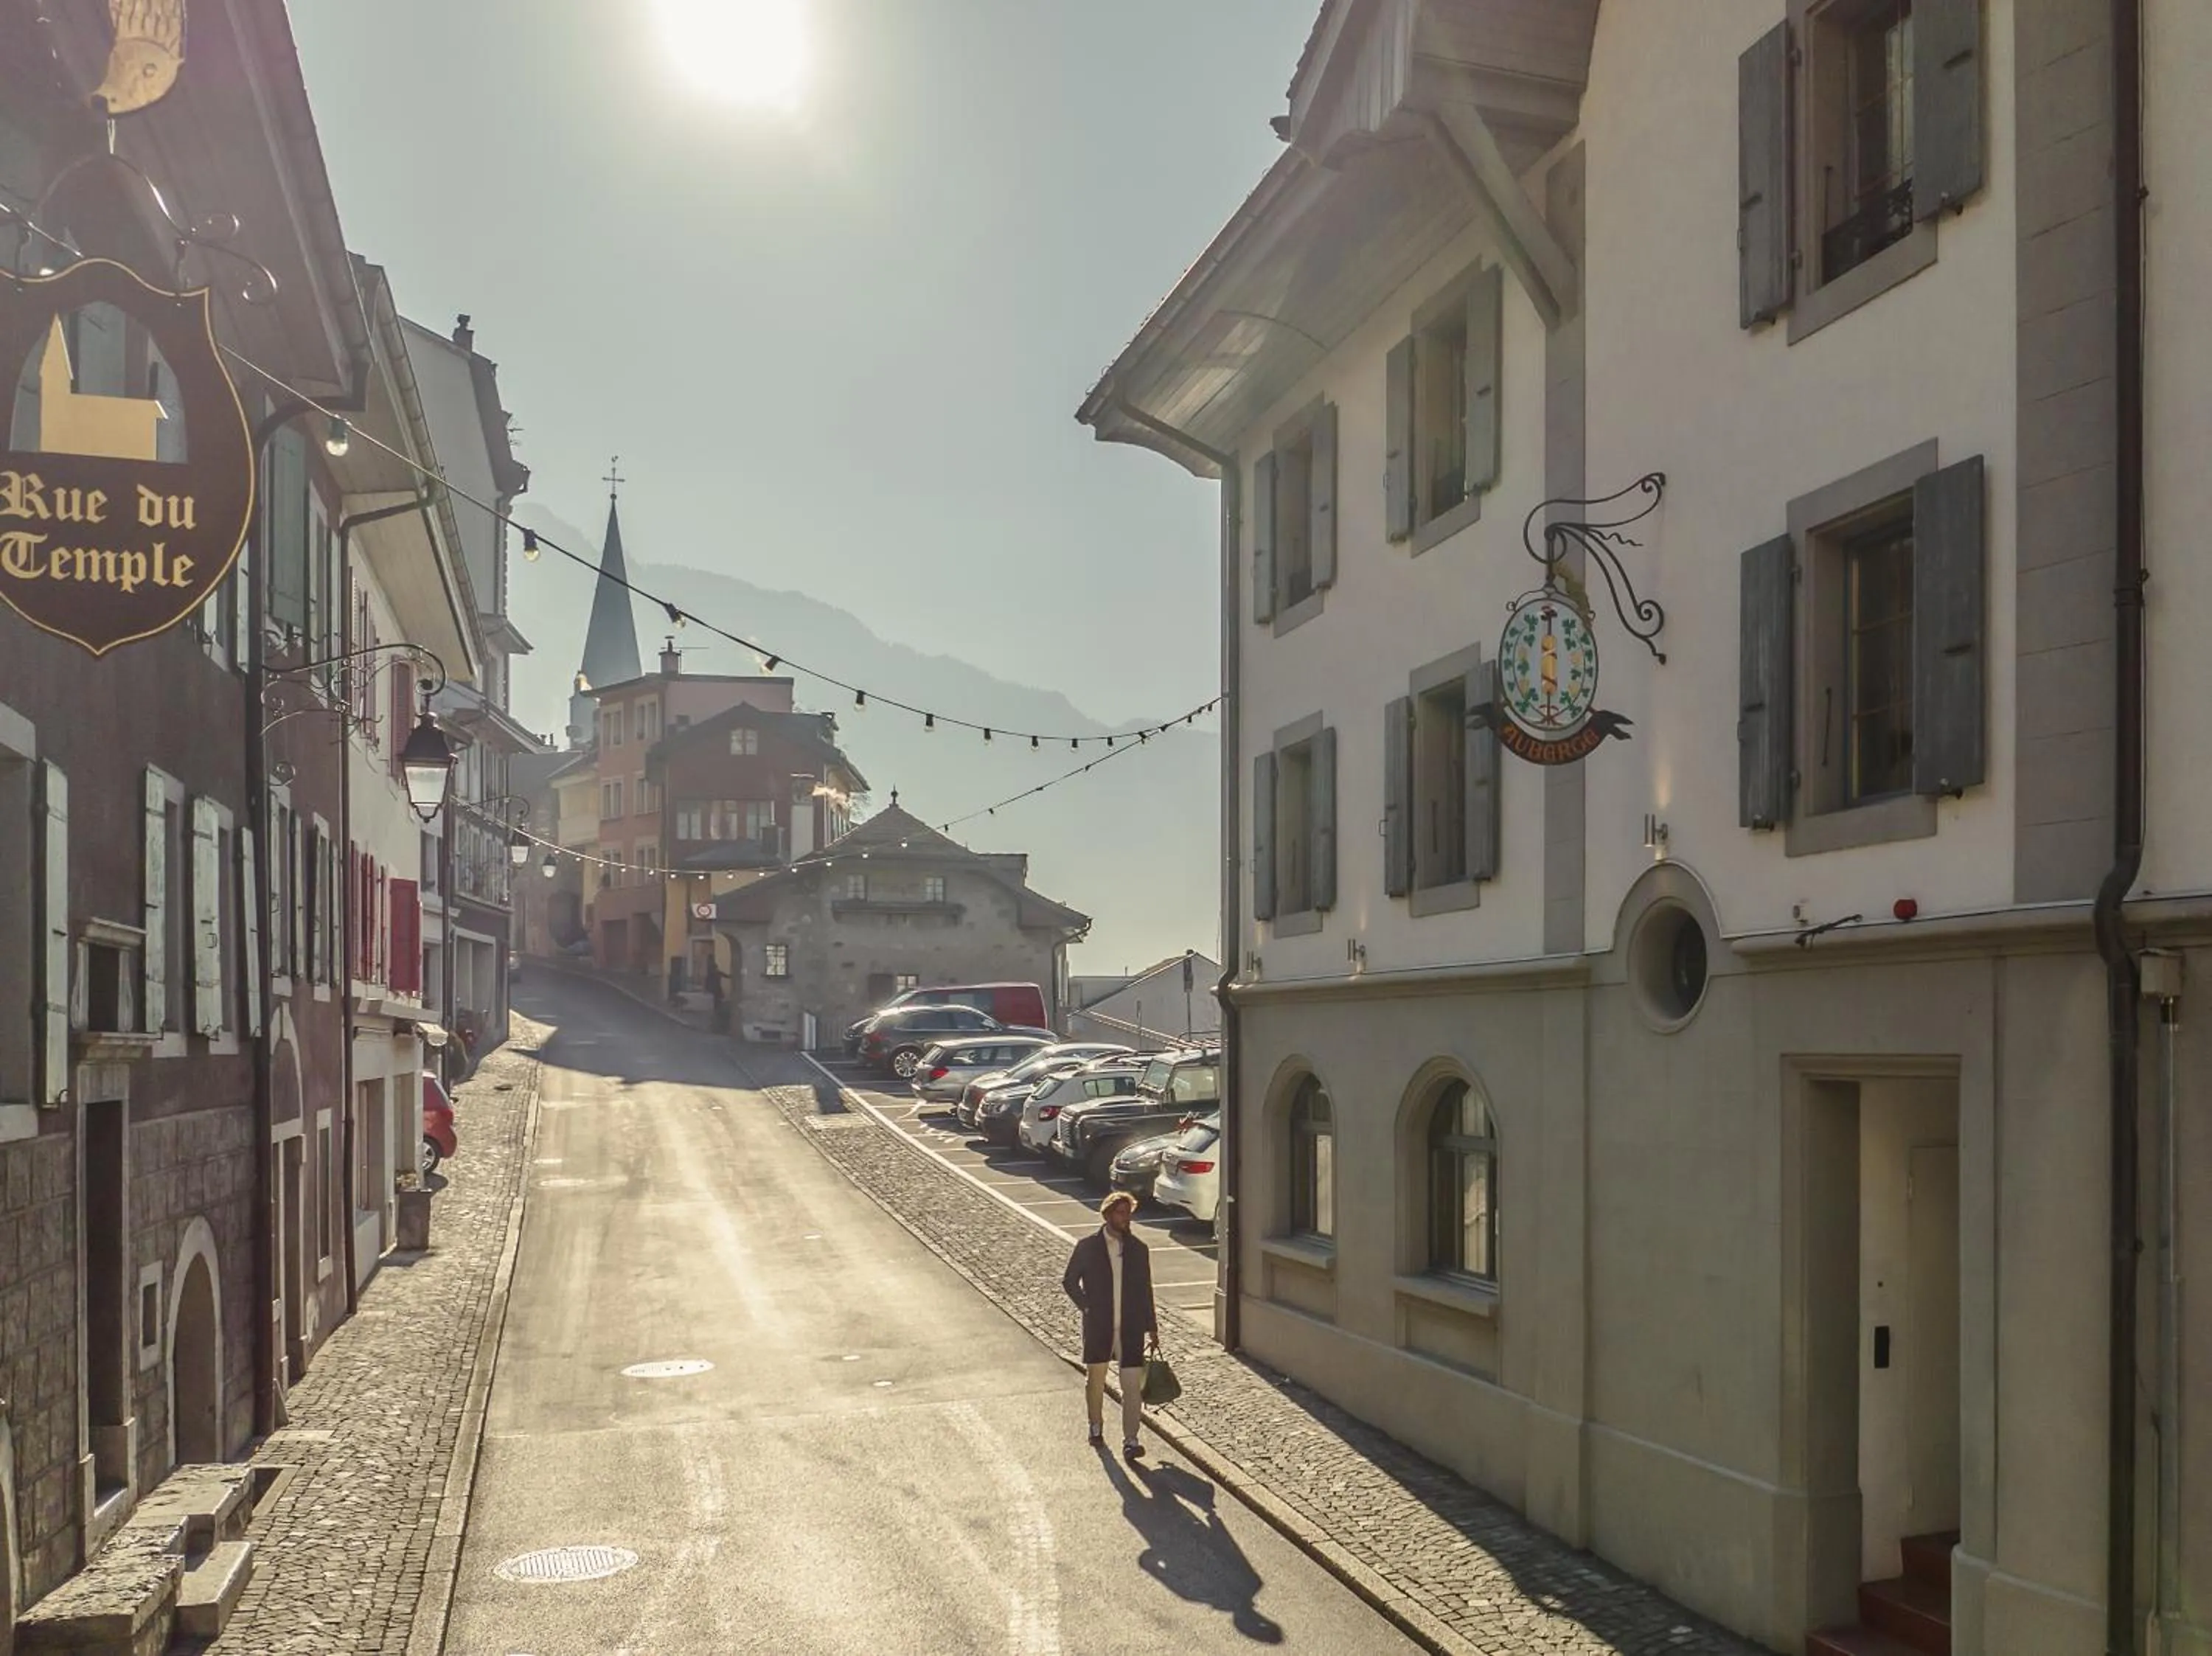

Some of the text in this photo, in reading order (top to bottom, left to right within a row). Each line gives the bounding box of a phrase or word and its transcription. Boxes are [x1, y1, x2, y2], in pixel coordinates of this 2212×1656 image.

[0, 470, 196, 529] Rue du
[0, 531, 195, 594] Temple
